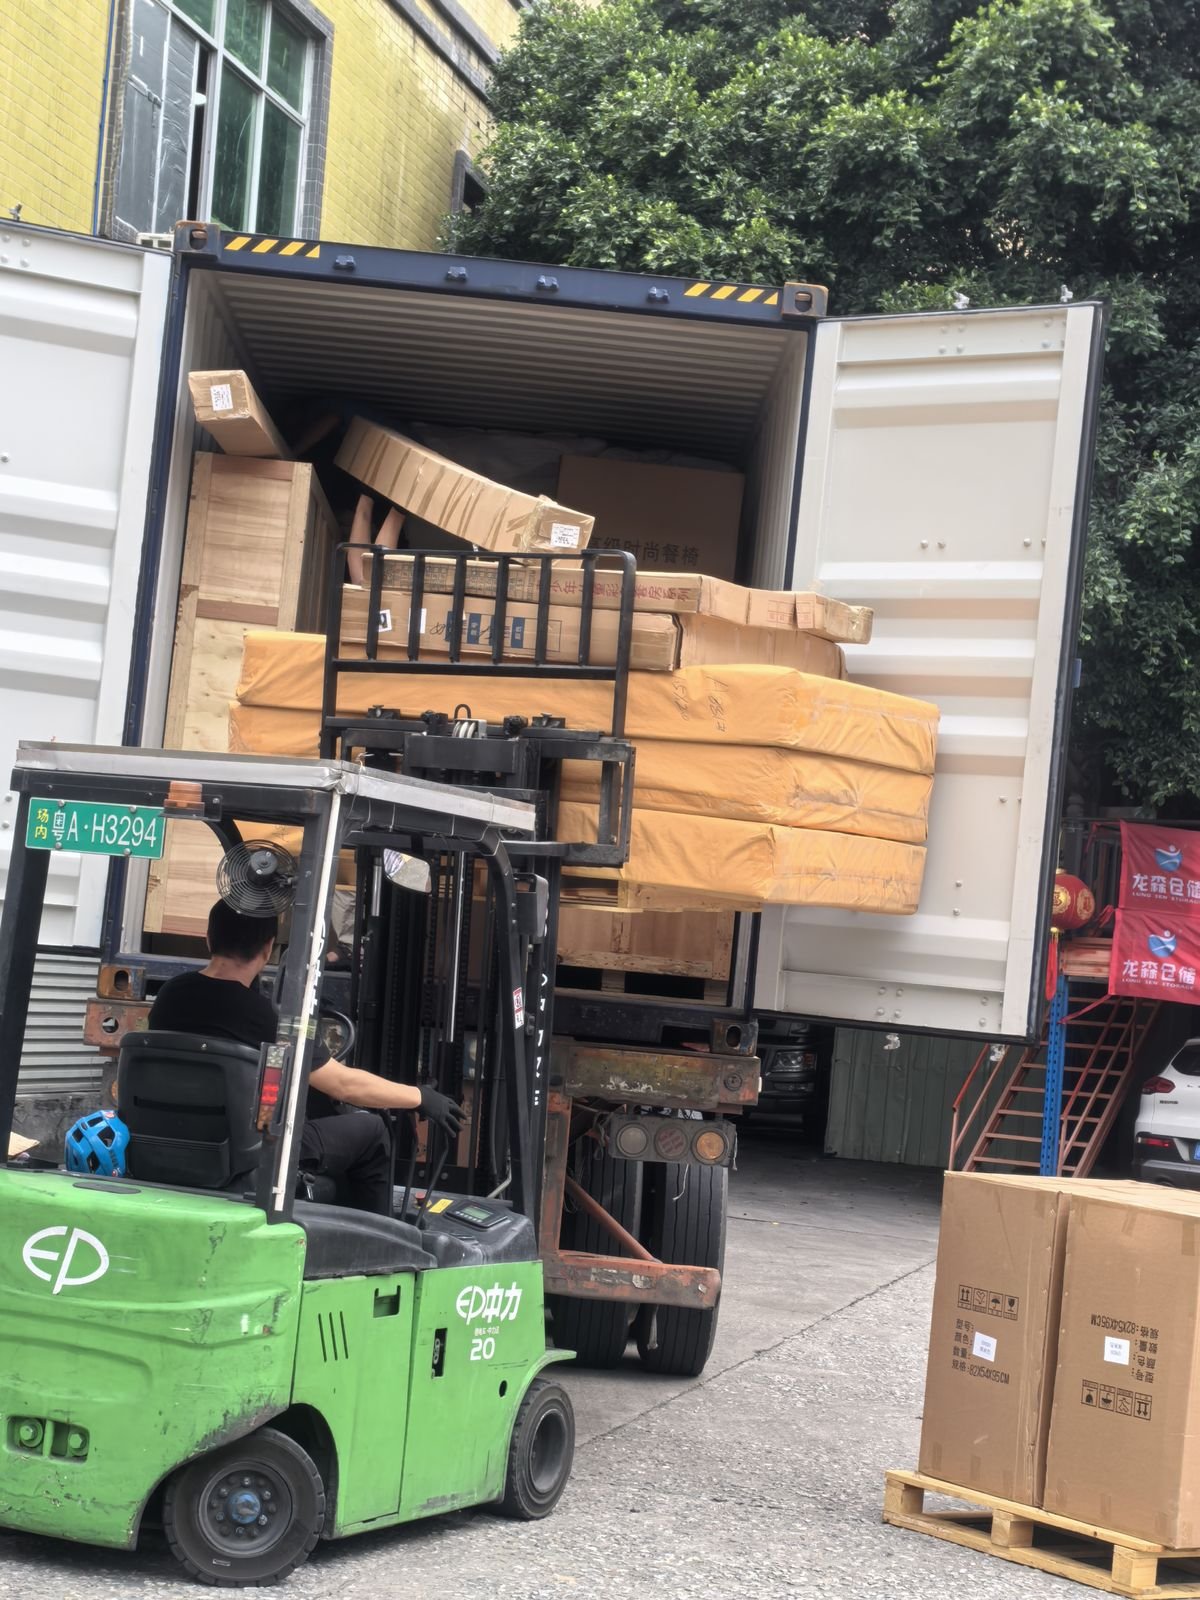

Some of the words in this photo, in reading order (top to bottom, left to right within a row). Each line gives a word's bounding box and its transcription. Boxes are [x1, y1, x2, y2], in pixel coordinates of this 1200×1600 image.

[536, 579, 692, 602] 少年童彩套房系列
[34, 808, 49, 840] 场内
[51, 810, 157, 848] 粤A·H3294
[1132, 872, 1200, 899] 龙森仓储
[1171, 897, 1200, 905] STORAG
[1122, 959, 1197, 985] 龙森仓储
[22, 1225, 110, 1295] EP
[470, 1337, 496, 1361] 20
